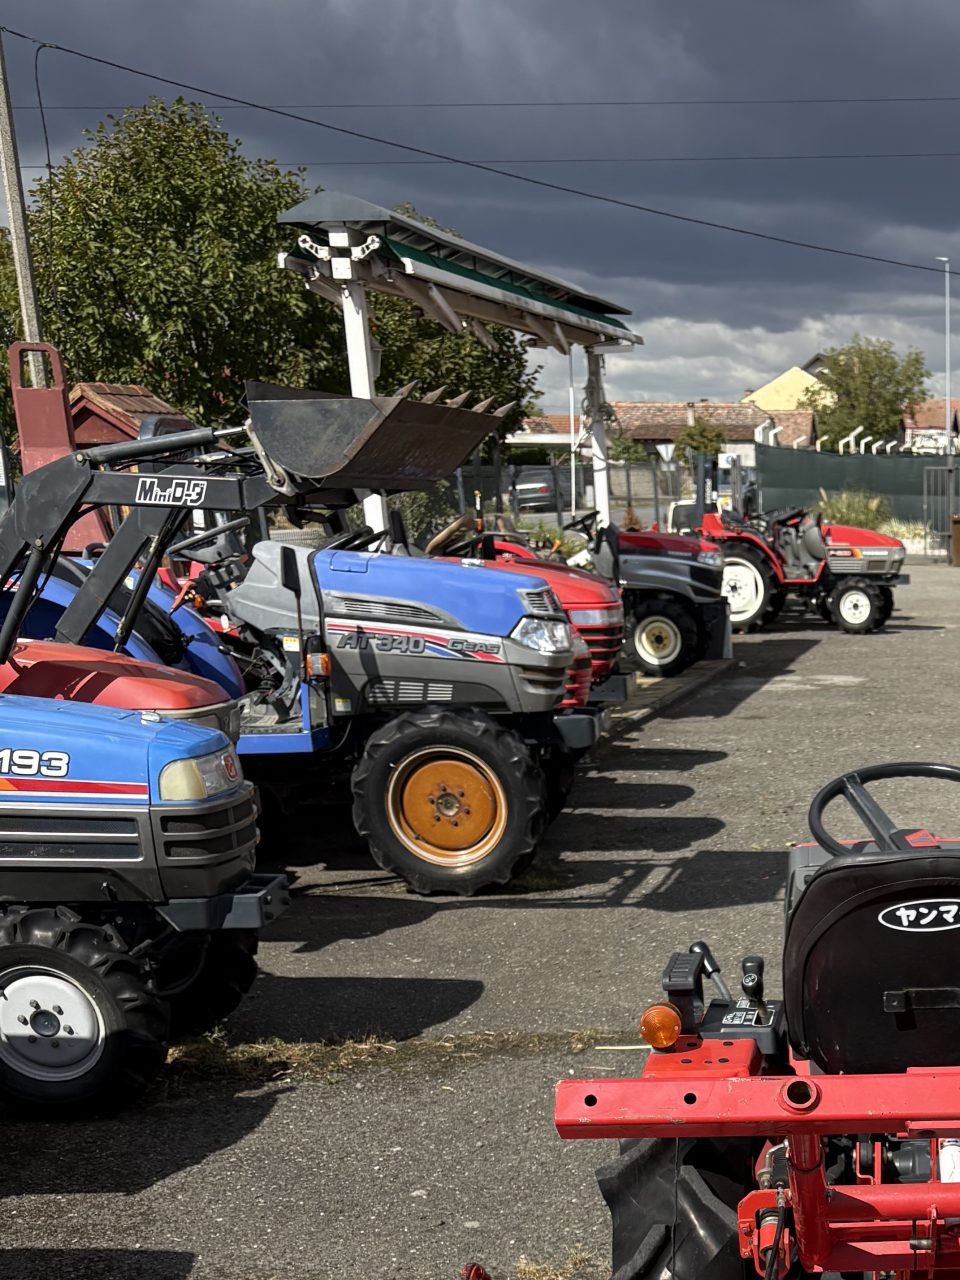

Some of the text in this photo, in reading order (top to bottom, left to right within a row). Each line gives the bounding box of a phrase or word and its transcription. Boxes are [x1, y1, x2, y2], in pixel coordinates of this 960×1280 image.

[337, 632, 375, 650] AT
[376, 634, 426, 654] 340
[0, 747, 70, 778] 193
